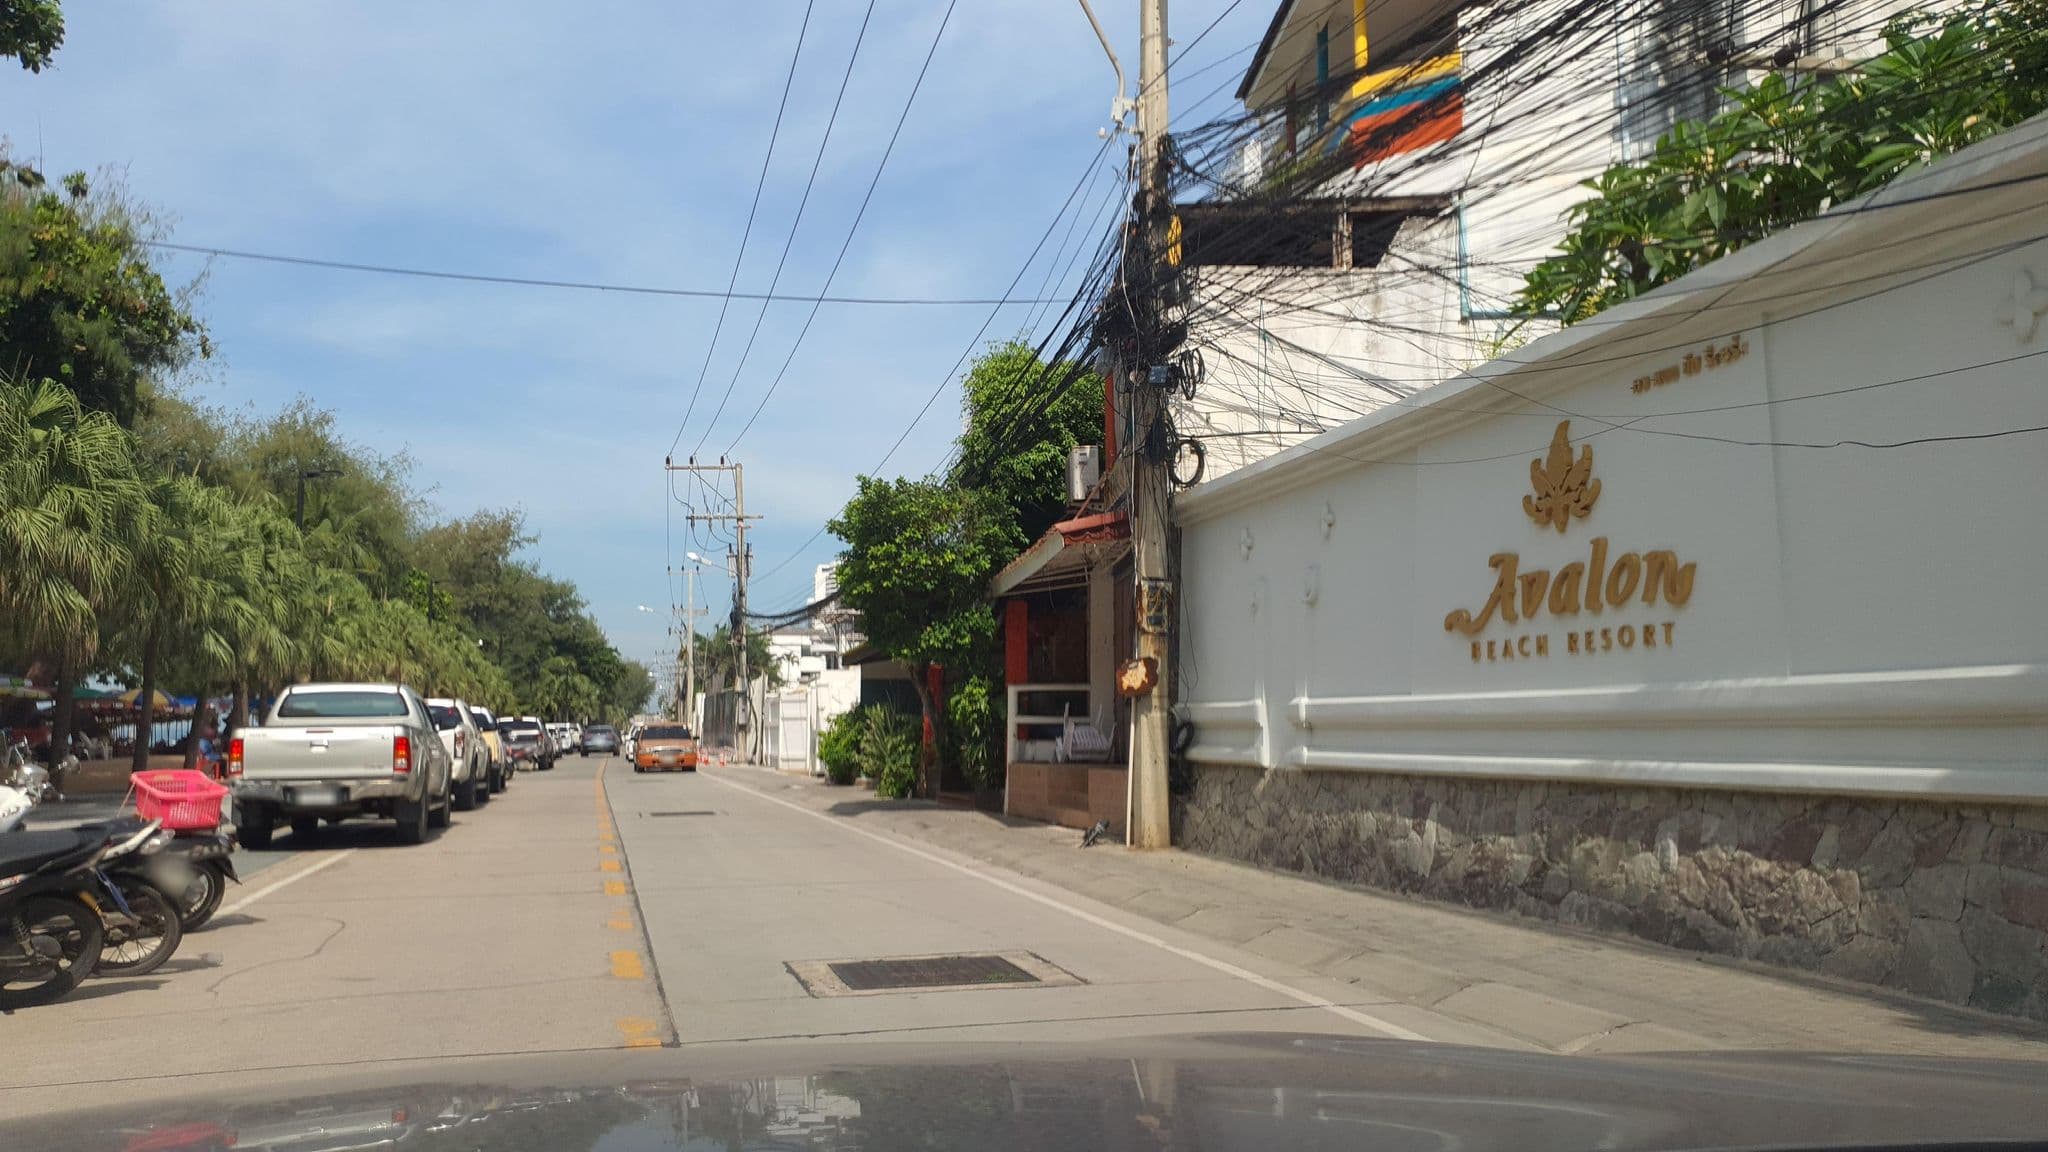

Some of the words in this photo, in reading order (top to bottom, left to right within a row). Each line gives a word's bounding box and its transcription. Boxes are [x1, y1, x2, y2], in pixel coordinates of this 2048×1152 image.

[1444, 536, 1697, 635] Avalon
[1471, 634, 1549, 663] BEACH
[1567, 621, 1676, 654] RESORT
